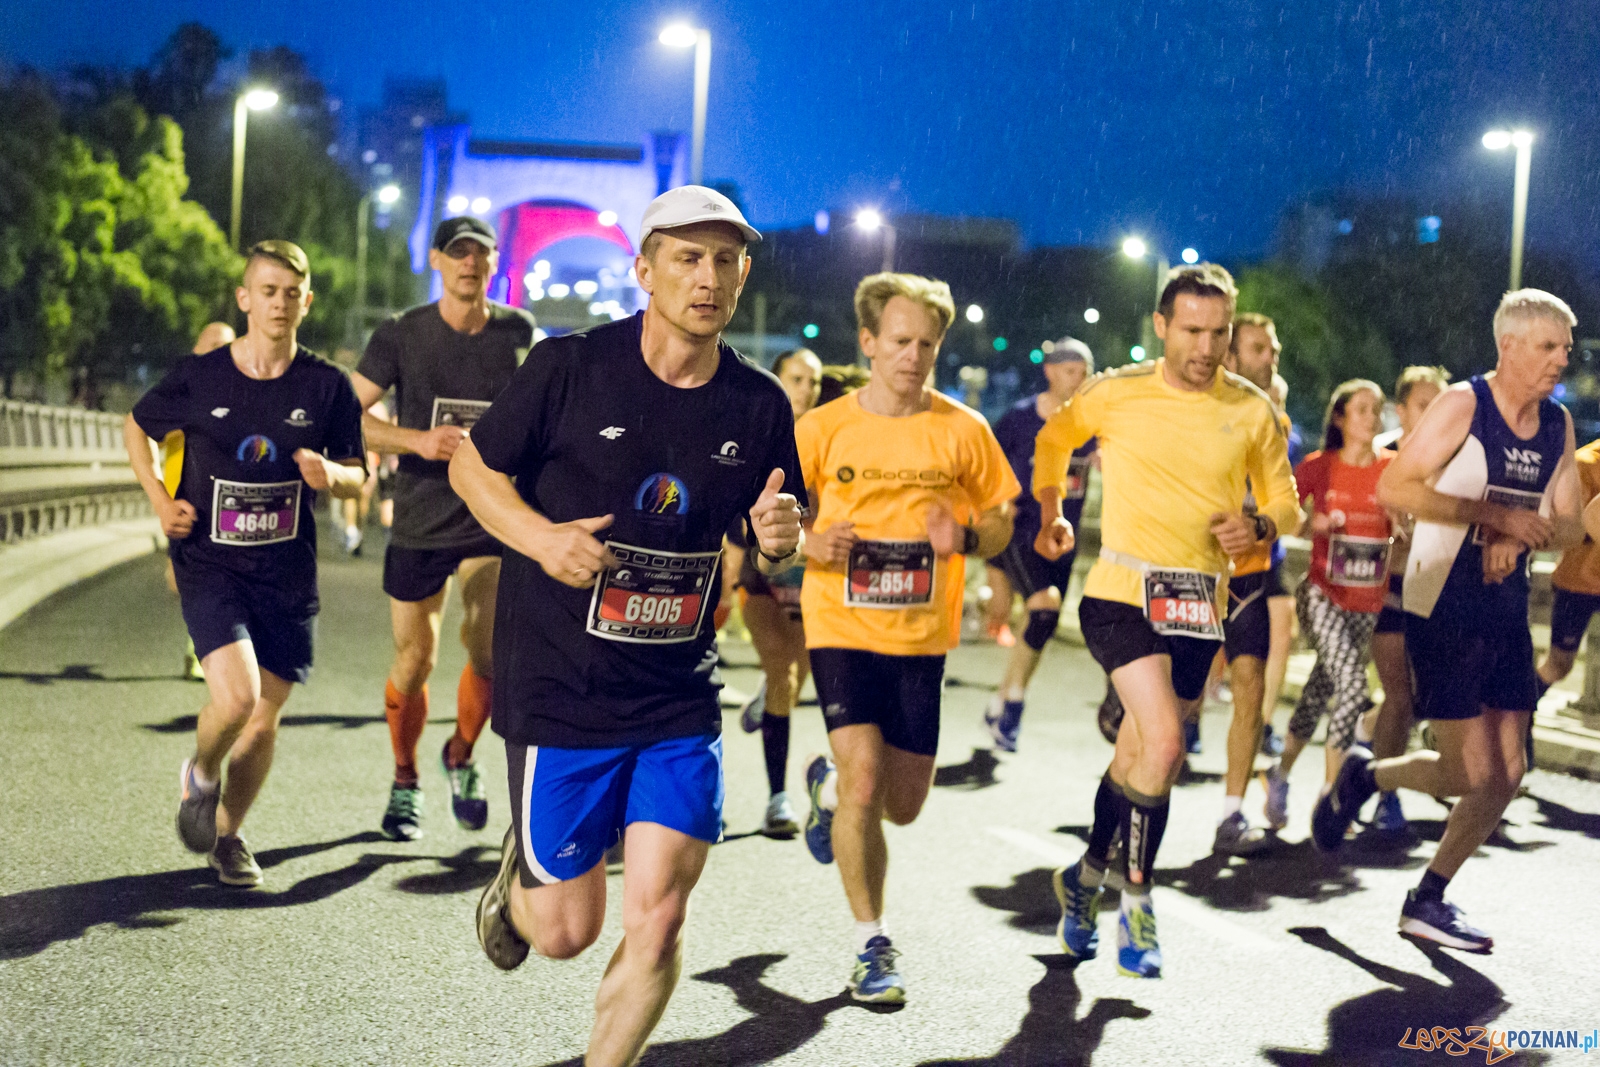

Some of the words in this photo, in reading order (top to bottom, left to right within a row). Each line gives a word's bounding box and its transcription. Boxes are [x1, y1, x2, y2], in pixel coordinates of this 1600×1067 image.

[599, 426, 626, 439] 4F
[234, 512, 279, 532] 4640
[868, 571, 914, 593] 2654
[625, 595, 683, 624] 6905
[1165, 599, 1210, 624] 3439
